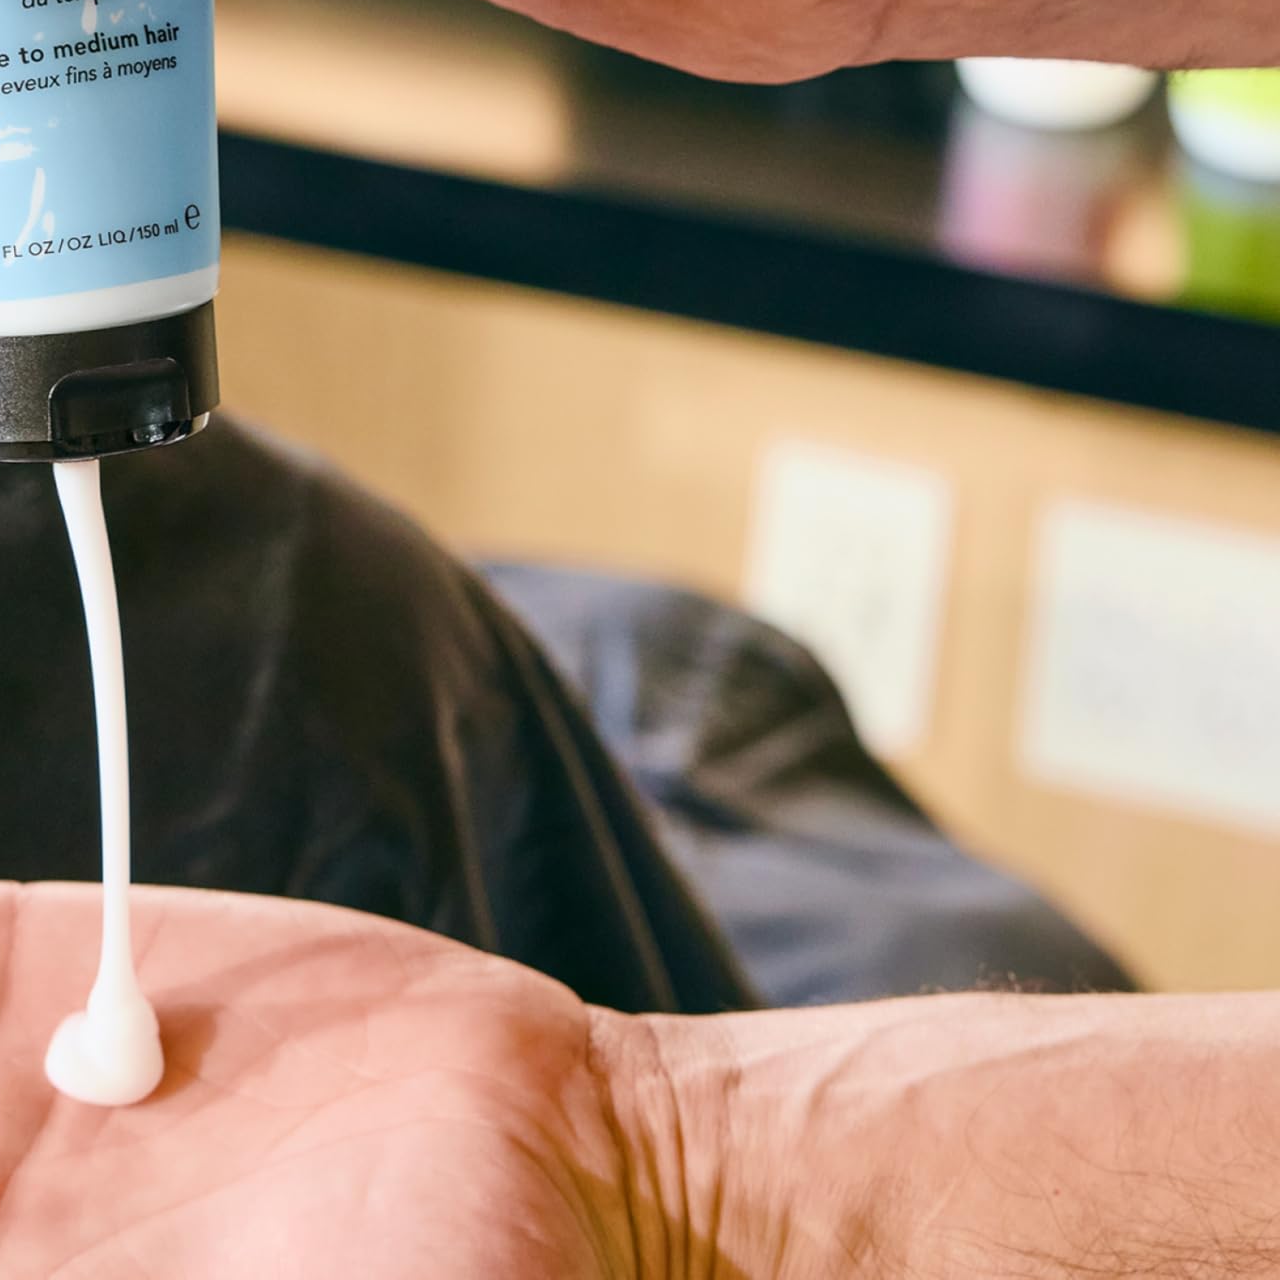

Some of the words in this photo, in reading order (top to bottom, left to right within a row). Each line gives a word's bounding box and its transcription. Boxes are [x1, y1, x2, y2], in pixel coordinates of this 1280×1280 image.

[18, 47, 44, 64] to
[53, 32, 139, 59] medium
[143, 23, 180, 45] hair
[65, 66, 98, 85] fins
[103, 61, 113, 79] à
[117, 54, 178, 78] moyens
[2, 245, 23, 259] FL
[164, 218, 179, 235] ml
